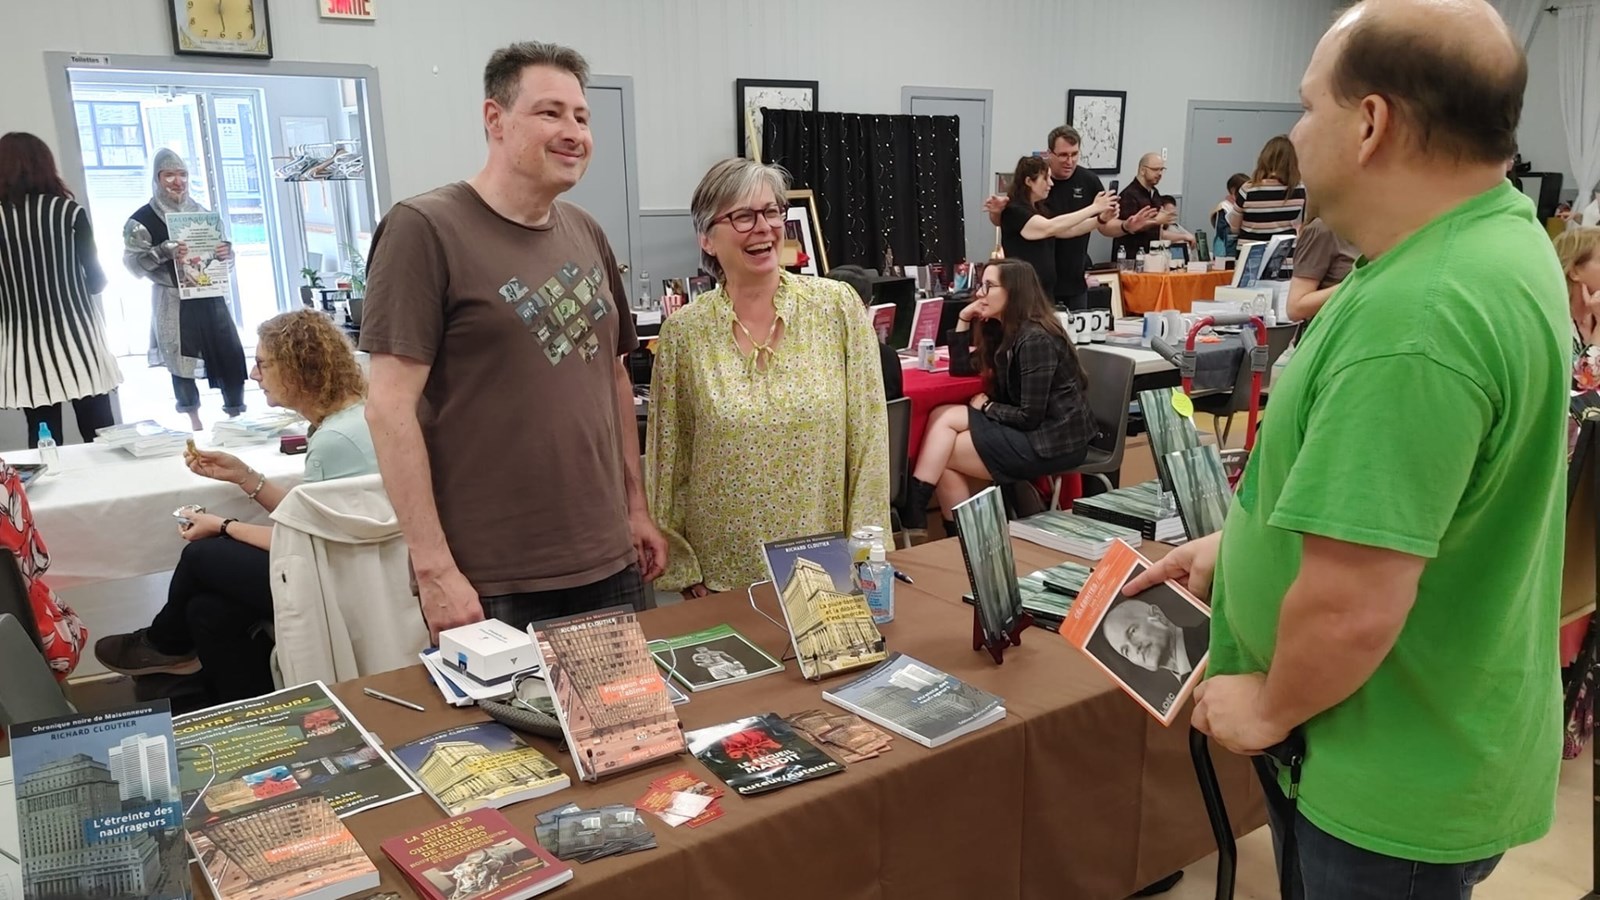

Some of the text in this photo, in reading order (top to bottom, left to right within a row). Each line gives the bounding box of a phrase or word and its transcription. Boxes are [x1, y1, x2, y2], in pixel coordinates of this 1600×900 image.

[785, 541, 830, 553] RICHARD CLOUTIER
[604, 681, 638, 692] Plongeon
[32, 707, 153, 733] Chronique noire de Maisonneuve
[173, 715, 234, 736] CONTRE
[245, 696, 312, 718] AUTEURS
[192, 708, 233, 721] bruncher
[51, 720, 137, 741] RICHARD CLOUTIER
[200, 743, 244, 757] Rihard
[737, 749, 795, 769] LE RECUEIL
[217, 750, 297, 774] Patrick Hamel
[744, 753, 801, 774] MAUDIT
[334, 794, 380, 811] nt-Jérôme
[93, 805, 173, 829] L'étreinte des
[99, 818, 166, 838] naufrageurs
[404, 816, 472, 844] LA NUIT DES
[422, 825, 465, 843] QUATRE
[409, 824, 486, 855] CHIRURGIENS
[421, 831, 488, 858] DE CHICAGO
